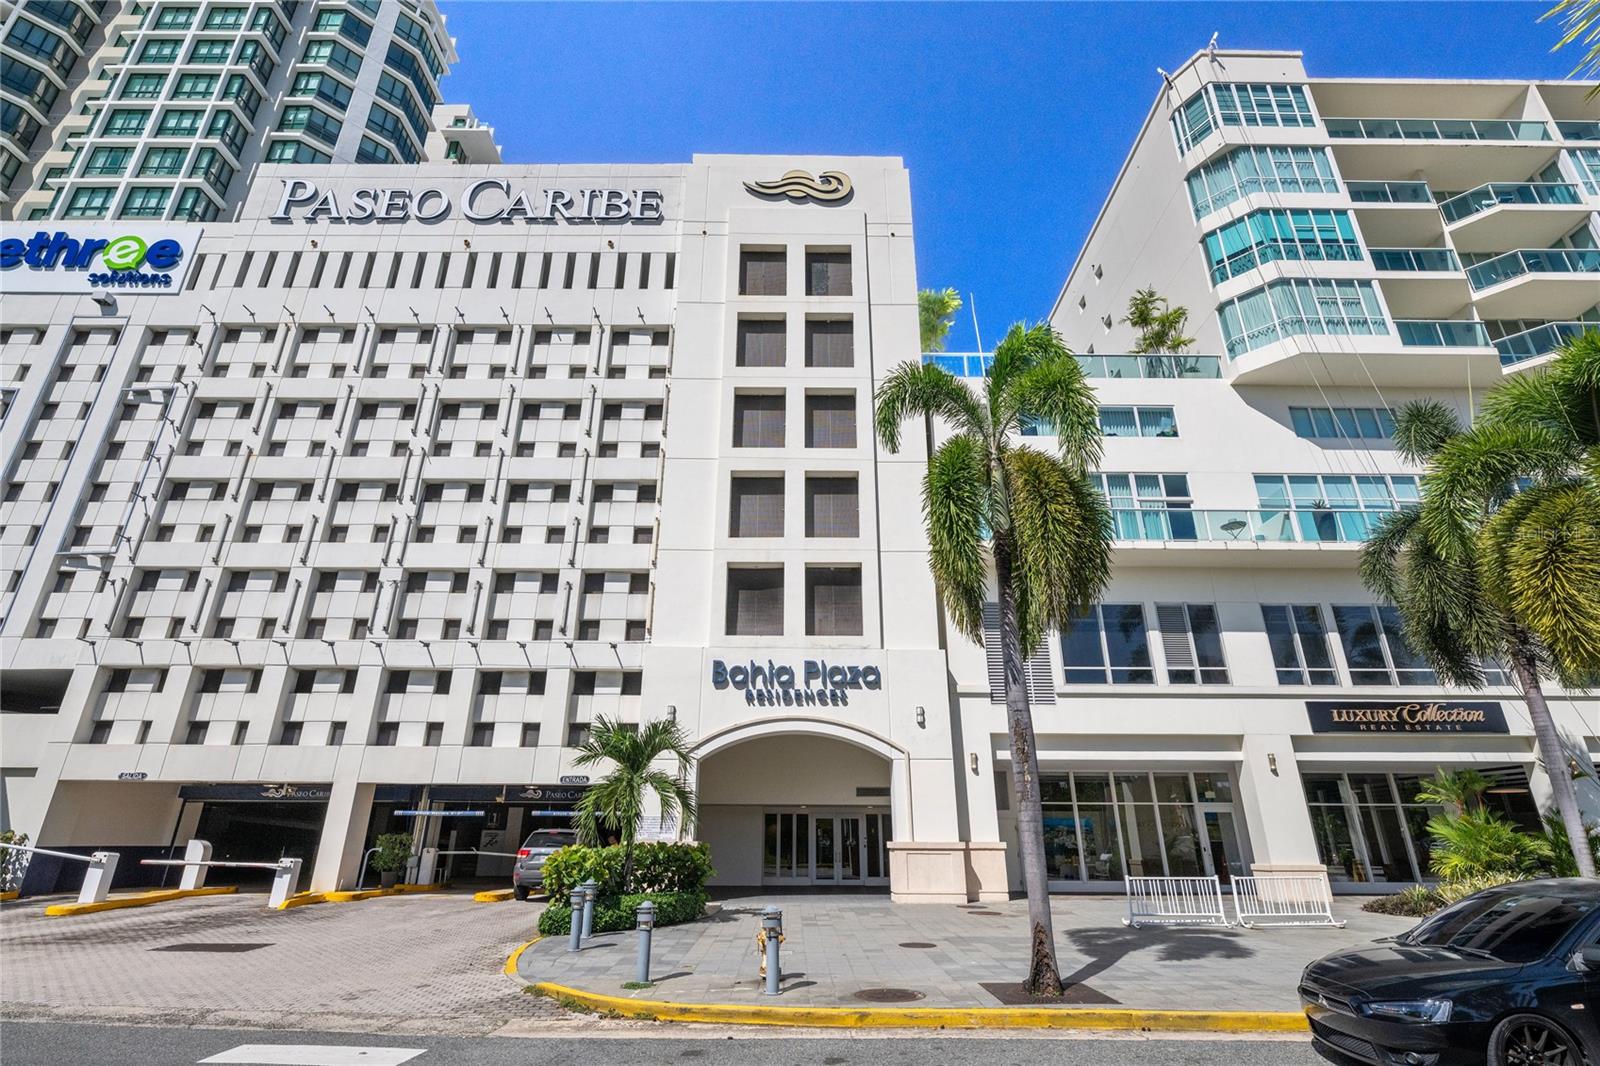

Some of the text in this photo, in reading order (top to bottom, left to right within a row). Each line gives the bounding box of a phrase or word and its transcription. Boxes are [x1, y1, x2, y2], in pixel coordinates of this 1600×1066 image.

[268, 179, 664, 226] PASEO CARIBE
[87, 270, 173, 288] solutions
[712, 659, 882, 690] Bahia Plaza
[745, 688, 849, 707] RESIDENCES
[1331, 703, 1485, 724] LUXURY Collection
[562, 776, 588, 784] ENTRADA
[309, 789, 331, 798] CARIB
[545, 791, 567, 799] PASEO
